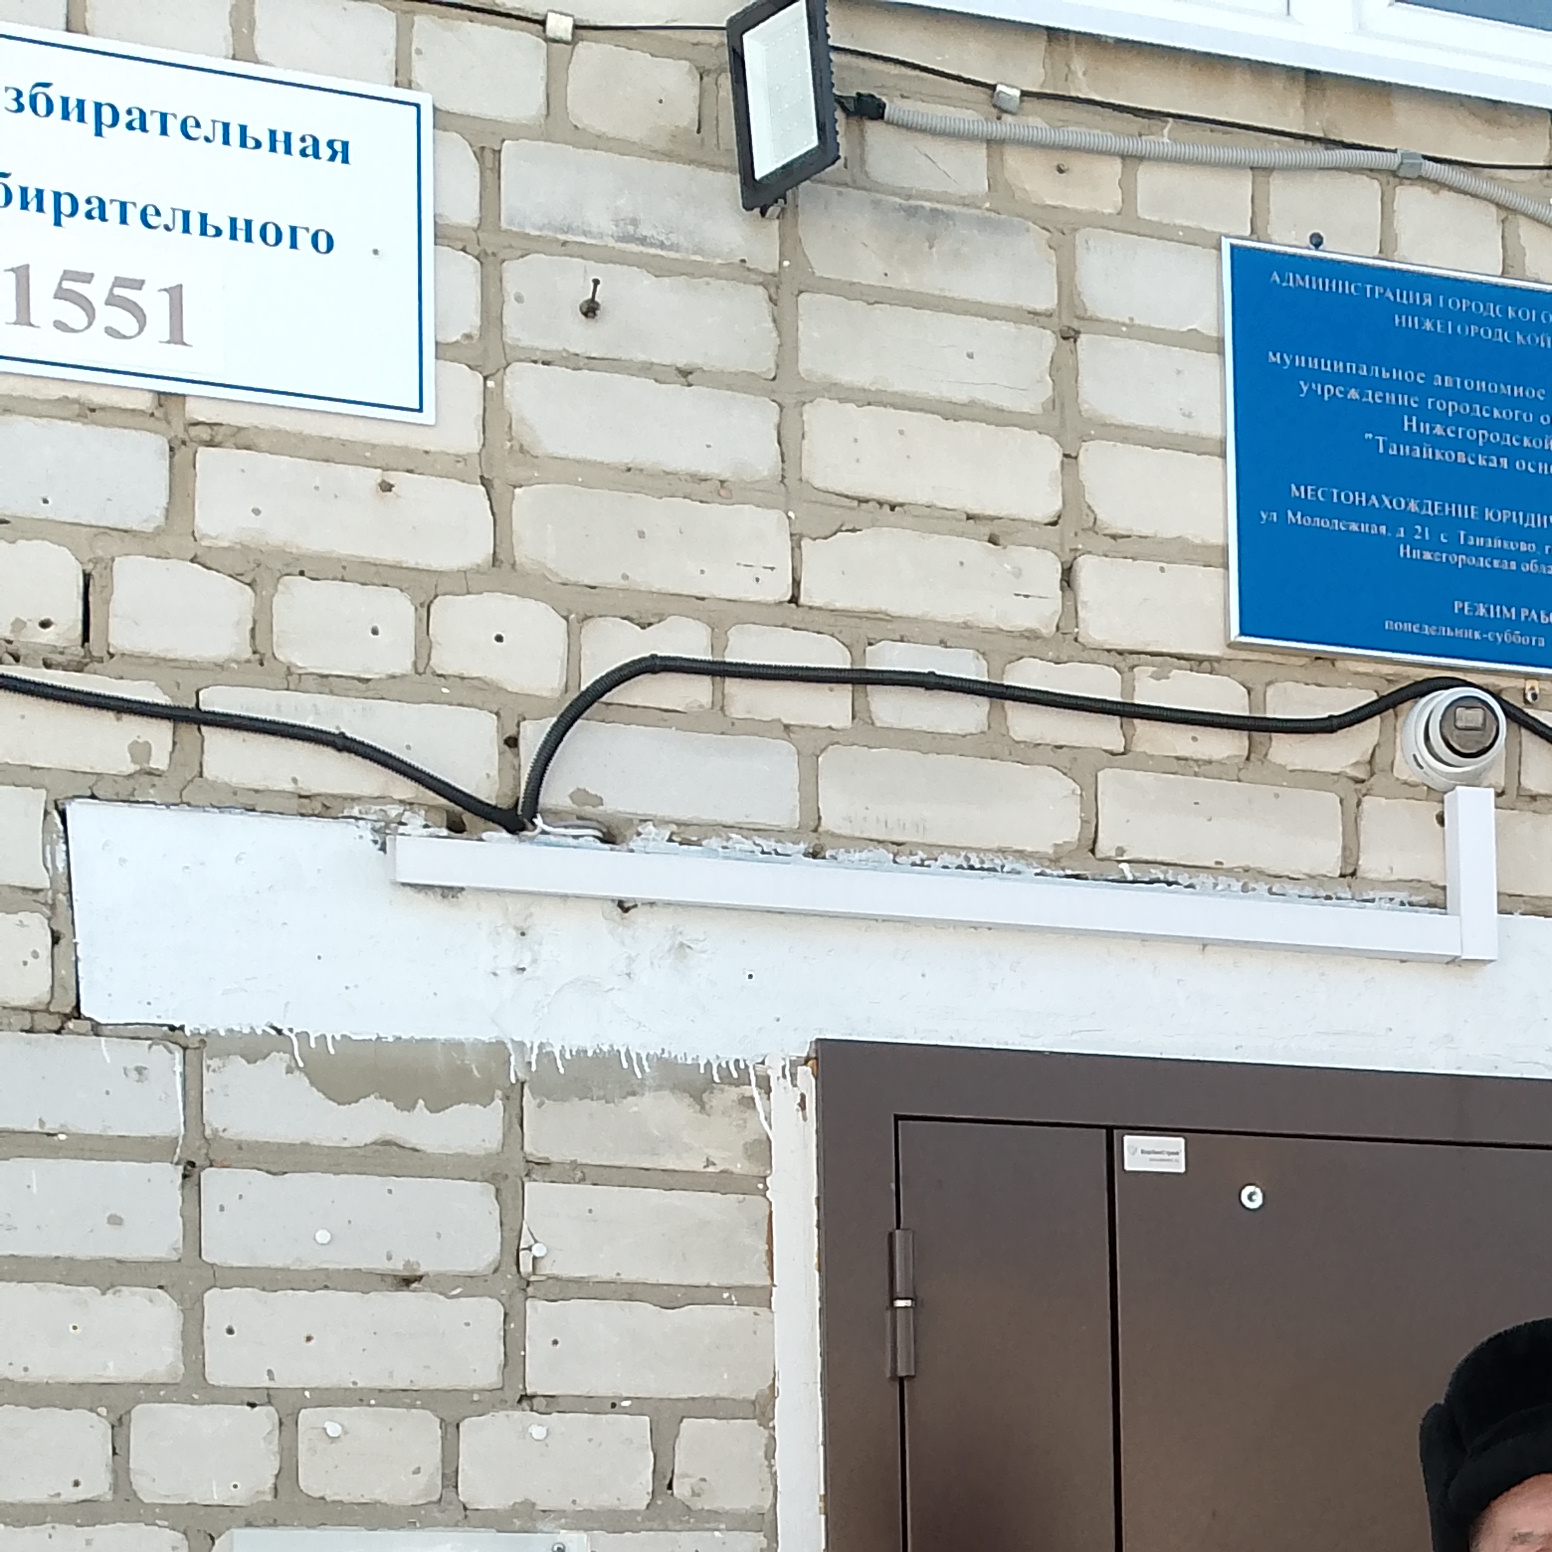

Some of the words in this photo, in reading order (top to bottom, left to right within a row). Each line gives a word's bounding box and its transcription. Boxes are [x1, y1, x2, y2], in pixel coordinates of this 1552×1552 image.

[4, 264, 193, 347] 1551
[1270, 271, 1433, 307] АДМИНИСТРАЦИЯ
[1439, 295, 1552, 324] ГОРОДСКОГО
[1394, 314, 1552, 349] НИЖЕГОРОДСКОЙ
[1268, 351, 1426, 384] муниципальное
[1433, 374, 1546, 401] автономное
[1298, 380, 1419, 408] учреждение
[1427, 397, 1533, 423] городского
[1290, 483, 1479, 520] МЕСТОНАХОЖДЕНИЕ
[1413, 524, 1430, 541] 21
[1399, 543, 1517, 571] Нижегородская
[1453, 600, 1516, 621] РЕЖИМ
